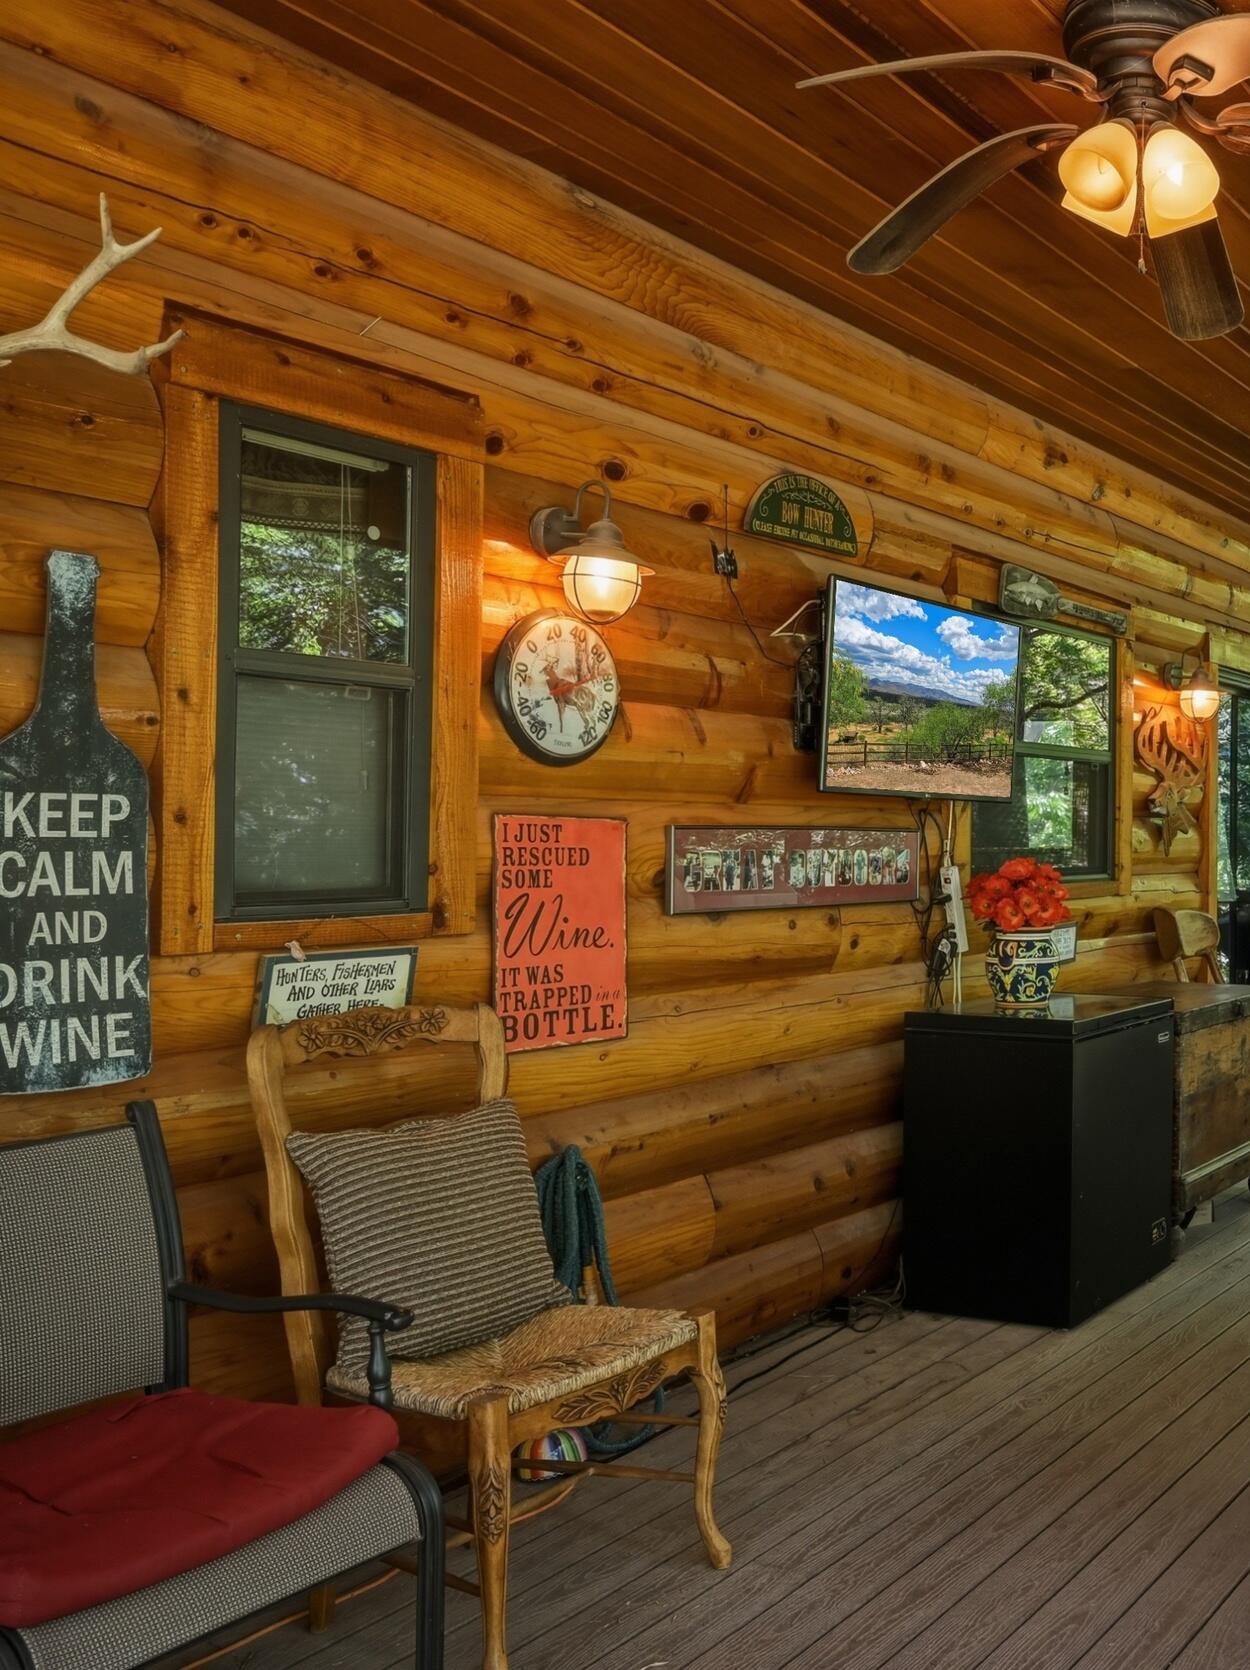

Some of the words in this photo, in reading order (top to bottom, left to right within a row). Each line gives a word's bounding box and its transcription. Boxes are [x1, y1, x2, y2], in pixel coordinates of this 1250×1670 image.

[781, 501, 800, 525] BOW
[803, 505, 834, 535] HUNTER
[547, 623, 562, 641] 20
[569, 625, 587, 643] 40
[526, 640, 538, 654] 0
[591, 644, 606, 664] 60
[514, 662, 528, 687] -20
[603, 673, 614, 693] 80
[517, 689, 532, 717] -40
[597, 700, 613, 725] 100
[527, 720, 547, 741] -60
[578, 726, 598, 747] 120
[4, 791, 131, 838] KEEP
[502, 823, 509, 843] I
[514, 823, 563, 843] JUST
[502, 846, 590, 867] RESCUED
[0, 850, 134, 898] CALM
[501, 869, 553, 889] SOME
[683, 848, 781, 894] GREAT
[787, 848, 911, 888] OUTDOORS
[28, 910, 108, 945] AND
[504, 892, 615, 959] Wine.
[0, 954, 147, 1008] DRINK
[501, 967, 520, 988] IT
[526, 963, 564, 986] WAS
[286, 985, 315, 1002] AND
[321, 980, 359, 997] OTHER
[364, 977, 397, 995] LIARS
[500, 984, 592, 1013] TRAPPED
[596, 985, 611, 1002] in
[612, 990, 621, 1001] a
[296, 1002, 341, 1019] GATHER
[500, 1003, 622, 1043] BOTTLE.
[0, 1012, 135, 1069] WINE
